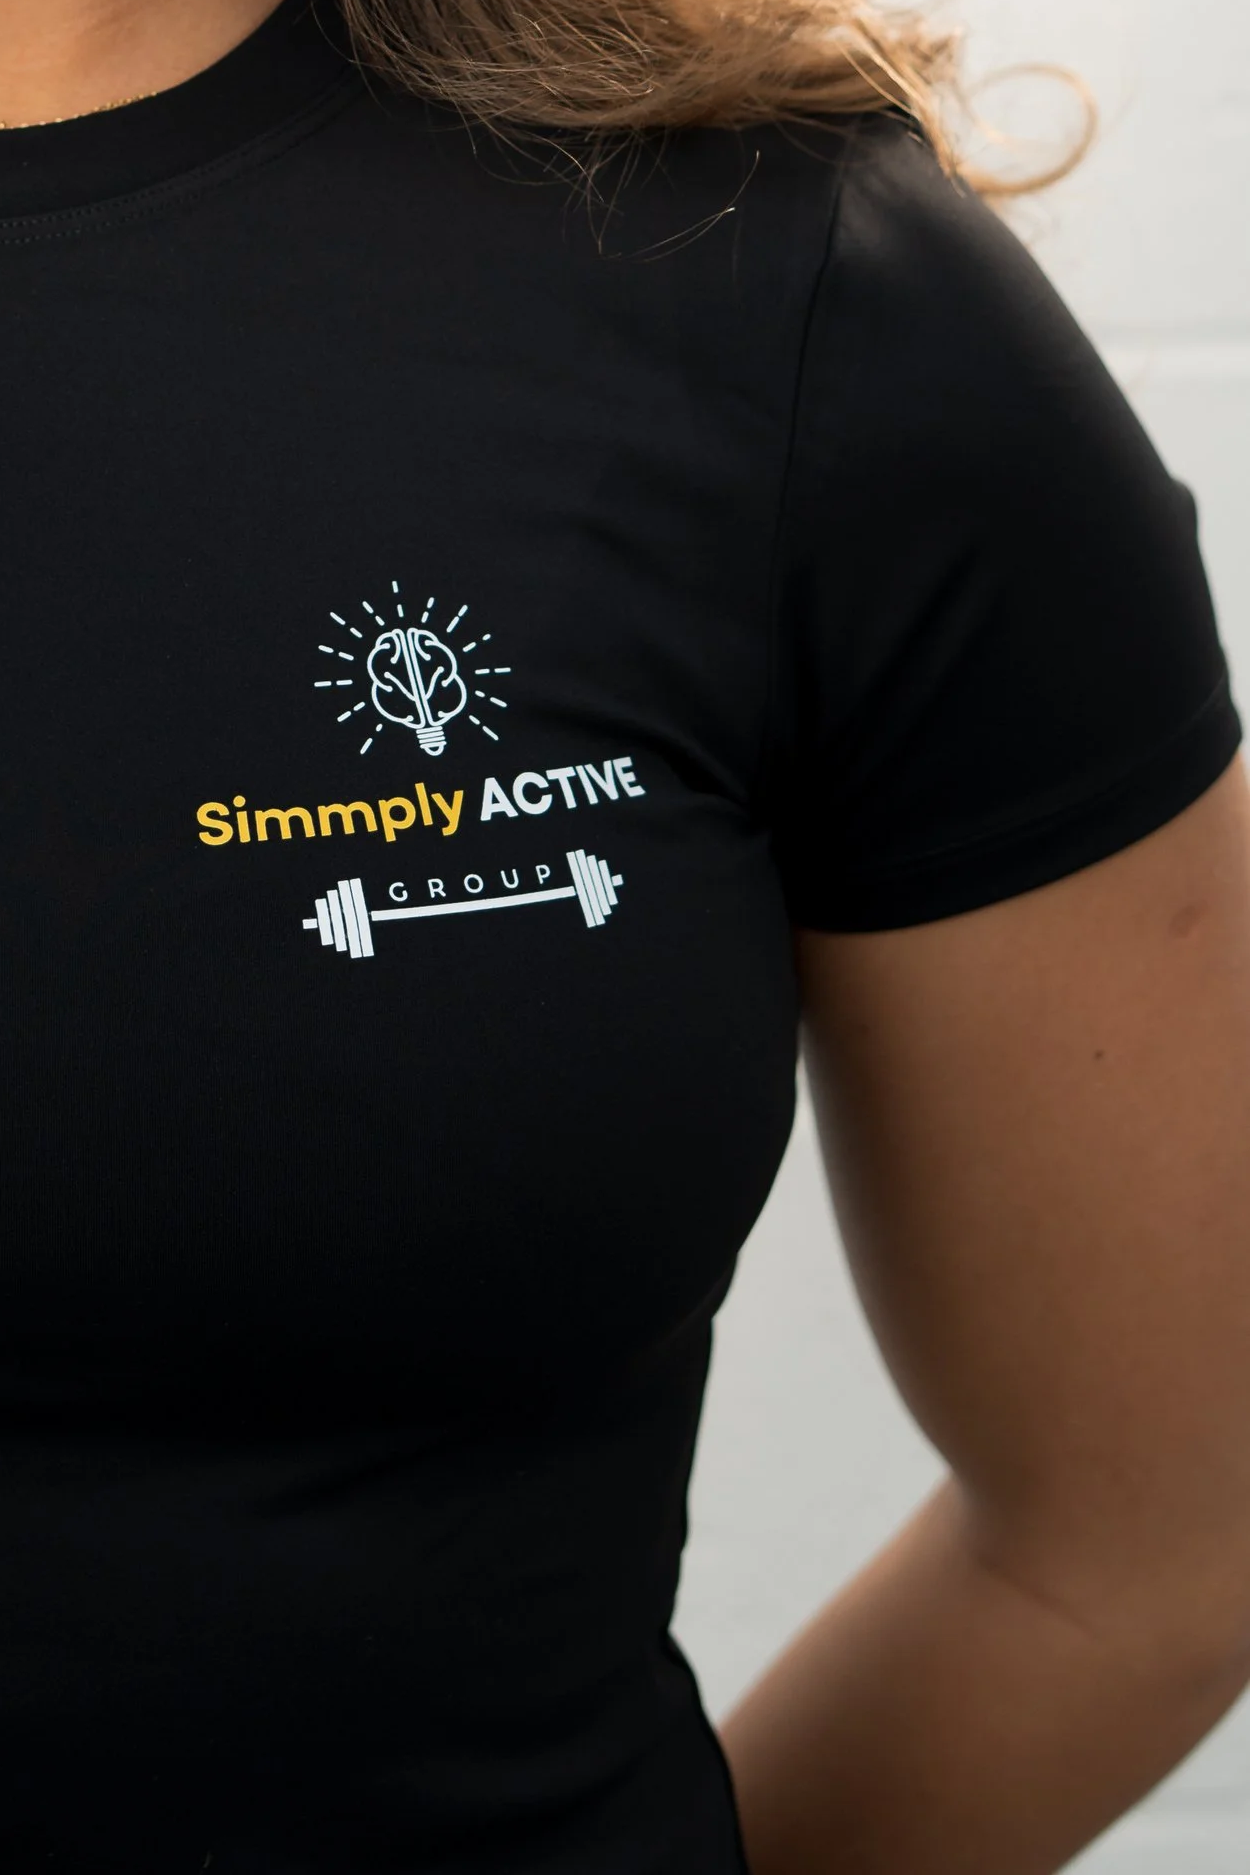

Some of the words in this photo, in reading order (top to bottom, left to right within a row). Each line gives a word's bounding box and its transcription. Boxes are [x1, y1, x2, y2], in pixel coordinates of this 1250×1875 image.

[196, 782, 464, 846] Simmply
[480, 756, 646, 822] ACTIVE
[388, 864, 551, 903] GROUP
